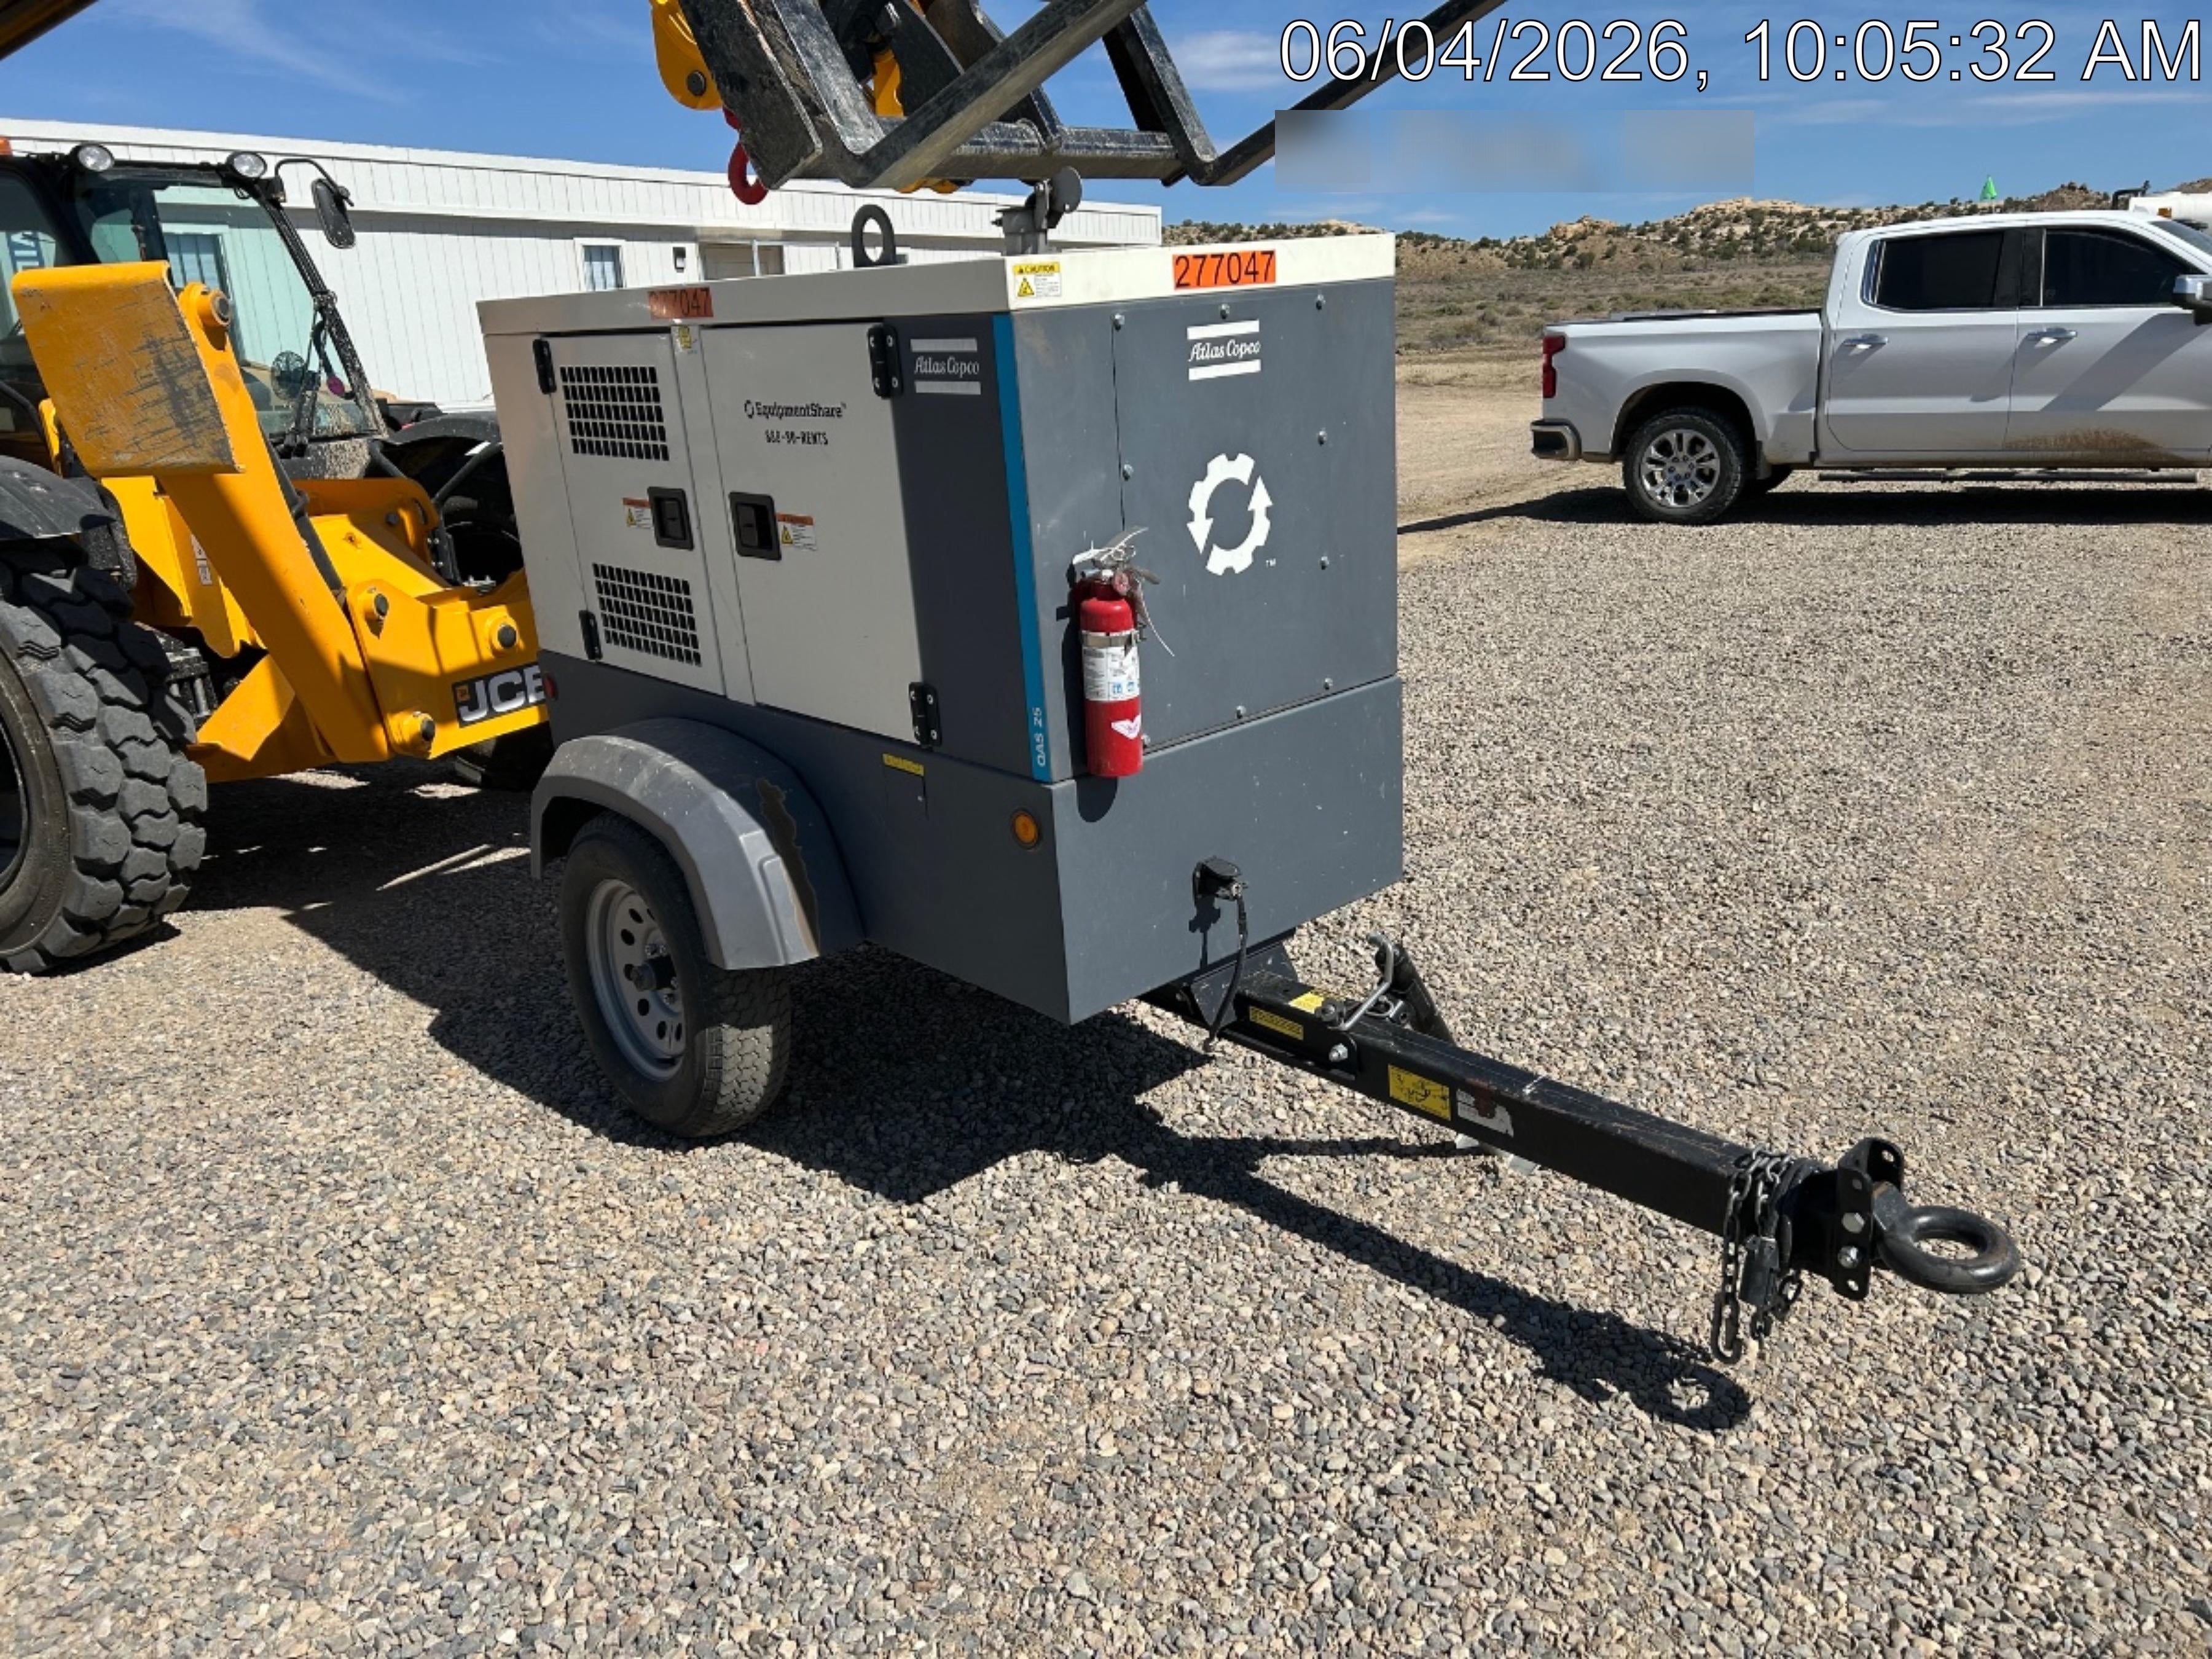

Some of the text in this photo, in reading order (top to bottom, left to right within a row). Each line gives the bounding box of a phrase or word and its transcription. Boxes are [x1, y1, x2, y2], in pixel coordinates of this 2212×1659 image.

[1175, 251, 1275, 288] 277047
[1188, 339, 1261, 361] Atlas Copco
[914, 356, 979, 378] Atlas Copco
[1034, 733, 1046, 767] QAS
